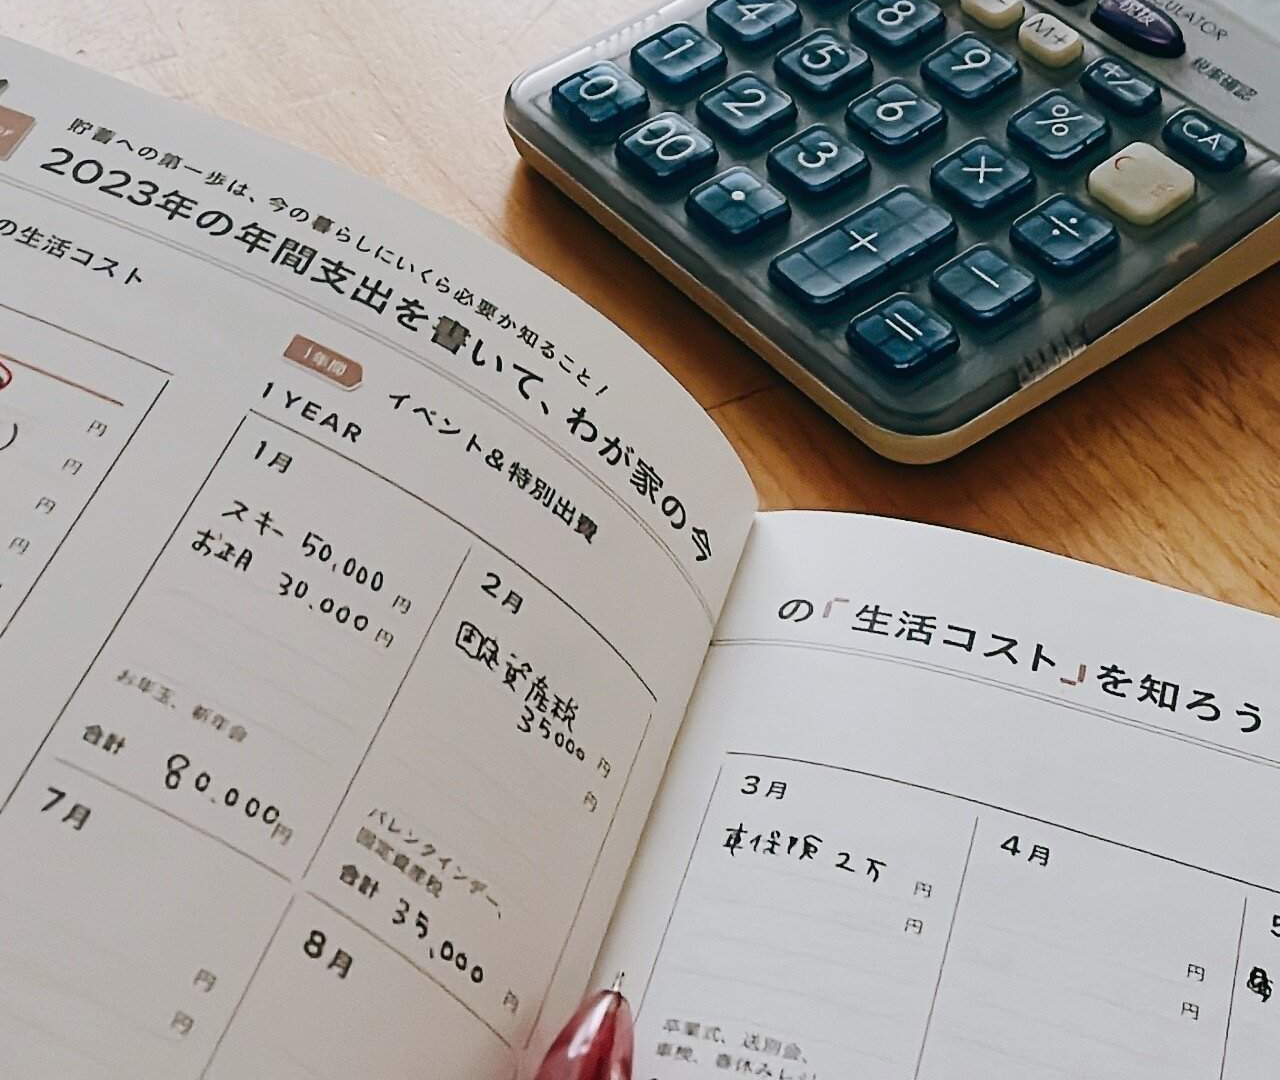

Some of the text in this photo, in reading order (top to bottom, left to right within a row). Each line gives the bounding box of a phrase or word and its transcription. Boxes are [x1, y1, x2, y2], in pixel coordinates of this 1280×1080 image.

[736, 2, 773, 21] 4
[877, 0, 916, 26] 8
[663, 39, 695, 60] 1
[802, 42, 846, 70] 5
[951, 48, 991, 71] 9
[579, 75, 618, 101] 0
[722, 88, 767, 117] 2
[876, 100, 916, 123] 6
[1036, 104, 1084, 136] %
[638, 120, 697, 161] 00
[1182, 119, 1222, 151] CA
[798, 141, 839, 168] 3
[262, 381, 364, 444] 1 YEAR
[253, 440, 293, 474] 1月
[221, 500, 284, 537] スキー
[191, 528, 253, 572] お正月
[481, 572, 524, 615] 2月
[776, 595, 1265, 734] の「生活コスト」を知ろう
[82, 724, 126, 755] 合計
[741, 776, 788, 800] 3月
[41, 786, 92, 831] 7月
[1000, 835, 1051, 867] 4月
[913, 881, 933, 899] 円
[904, 917, 924, 936] 円
[303, 929, 353, 980] 8月
[1187, 963, 1206, 982] 円
[1181, 1001, 1200, 1021] 円
